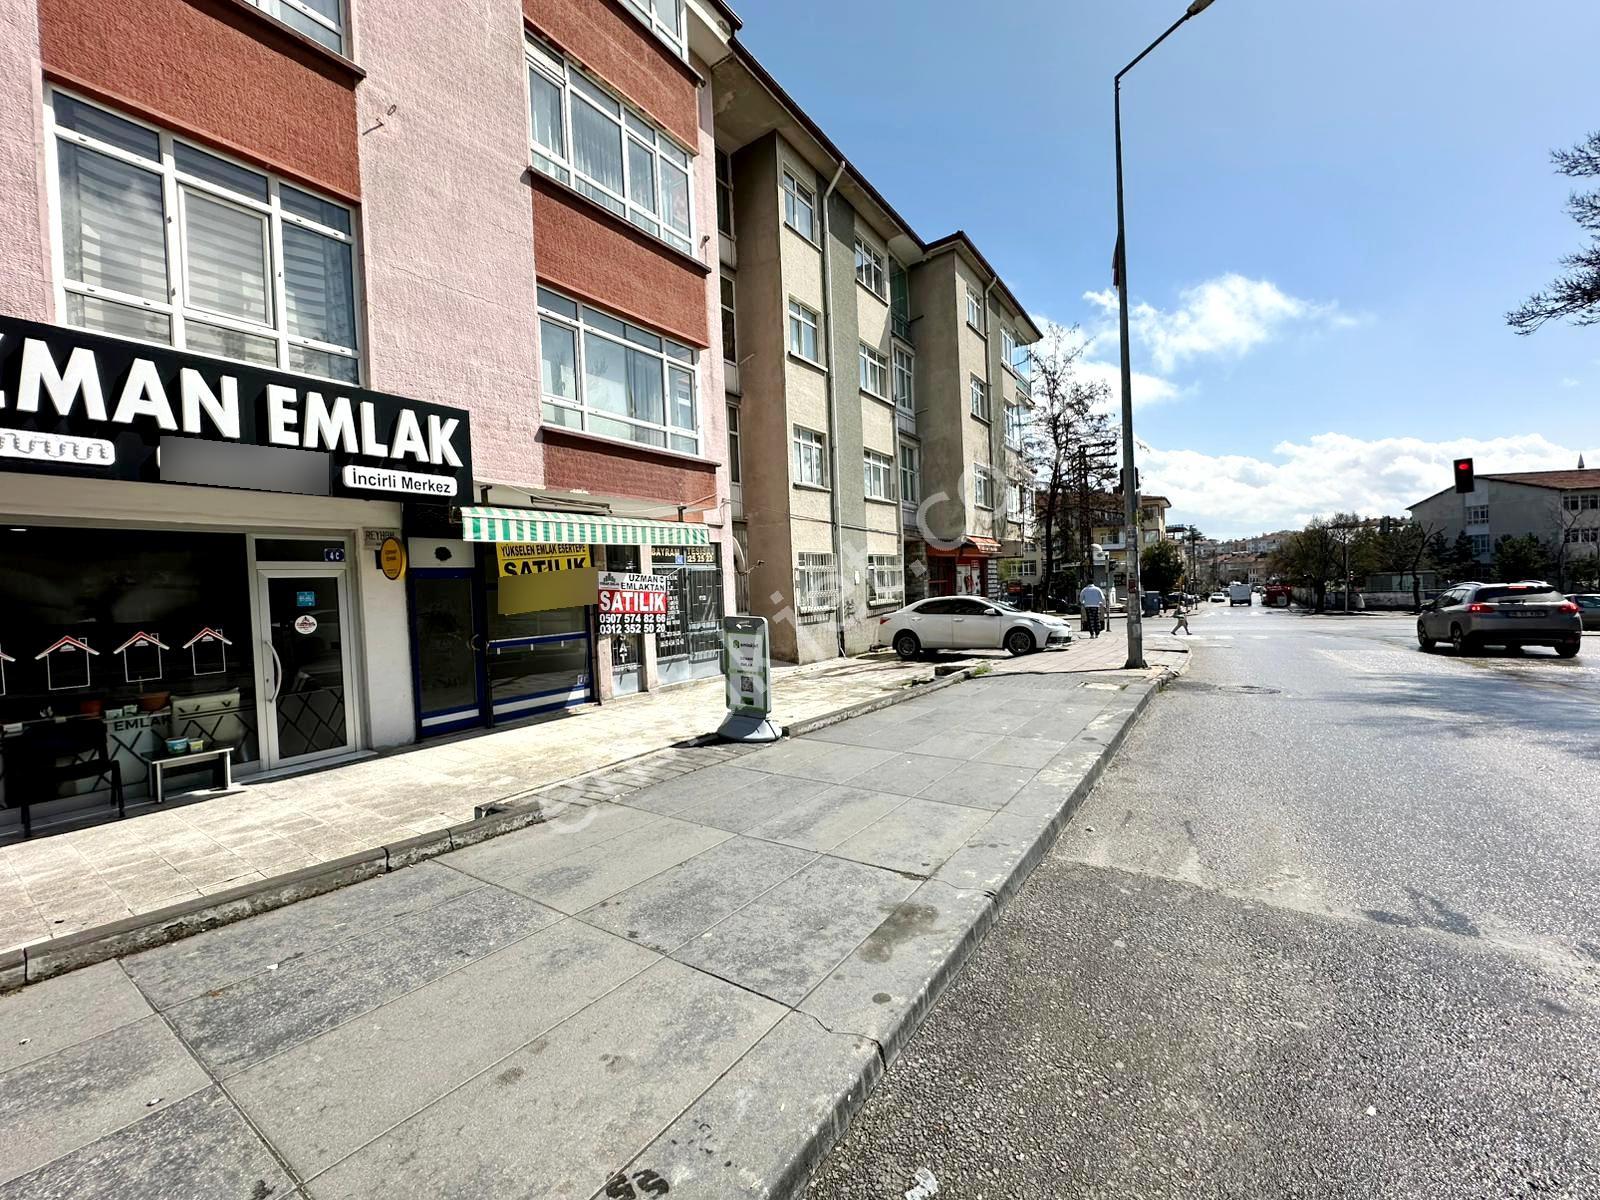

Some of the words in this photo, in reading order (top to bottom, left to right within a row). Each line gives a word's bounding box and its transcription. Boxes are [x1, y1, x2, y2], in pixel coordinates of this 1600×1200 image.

[0, 333, 240, 439] MAN
[266, 384, 464, 467] EMLAK
[352, 467, 397, 489] İncirli
[401, 475, 451, 494] Merkez
[501, 543, 535, 557] YÜKSELEN
[536, 544, 558, 555] EMLAK
[558, 543, 586, 554] ESERTEPE
[629, 574, 658, 583] UZMAN
[620, 582, 665, 591] EMLAKTAN
[600, 590, 666, 611] SATILIK
[600, 613, 622, 624] 0507
[624, 613, 642, 623] 574
[643, 613, 655, 623] 82
[656, 613, 666, 623] 66
[600, 624, 622, 634] 0312
[624, 624, 642, 634] 352
[643, 624, 655, 633] 50
[656, 624, 666, 633] 20
